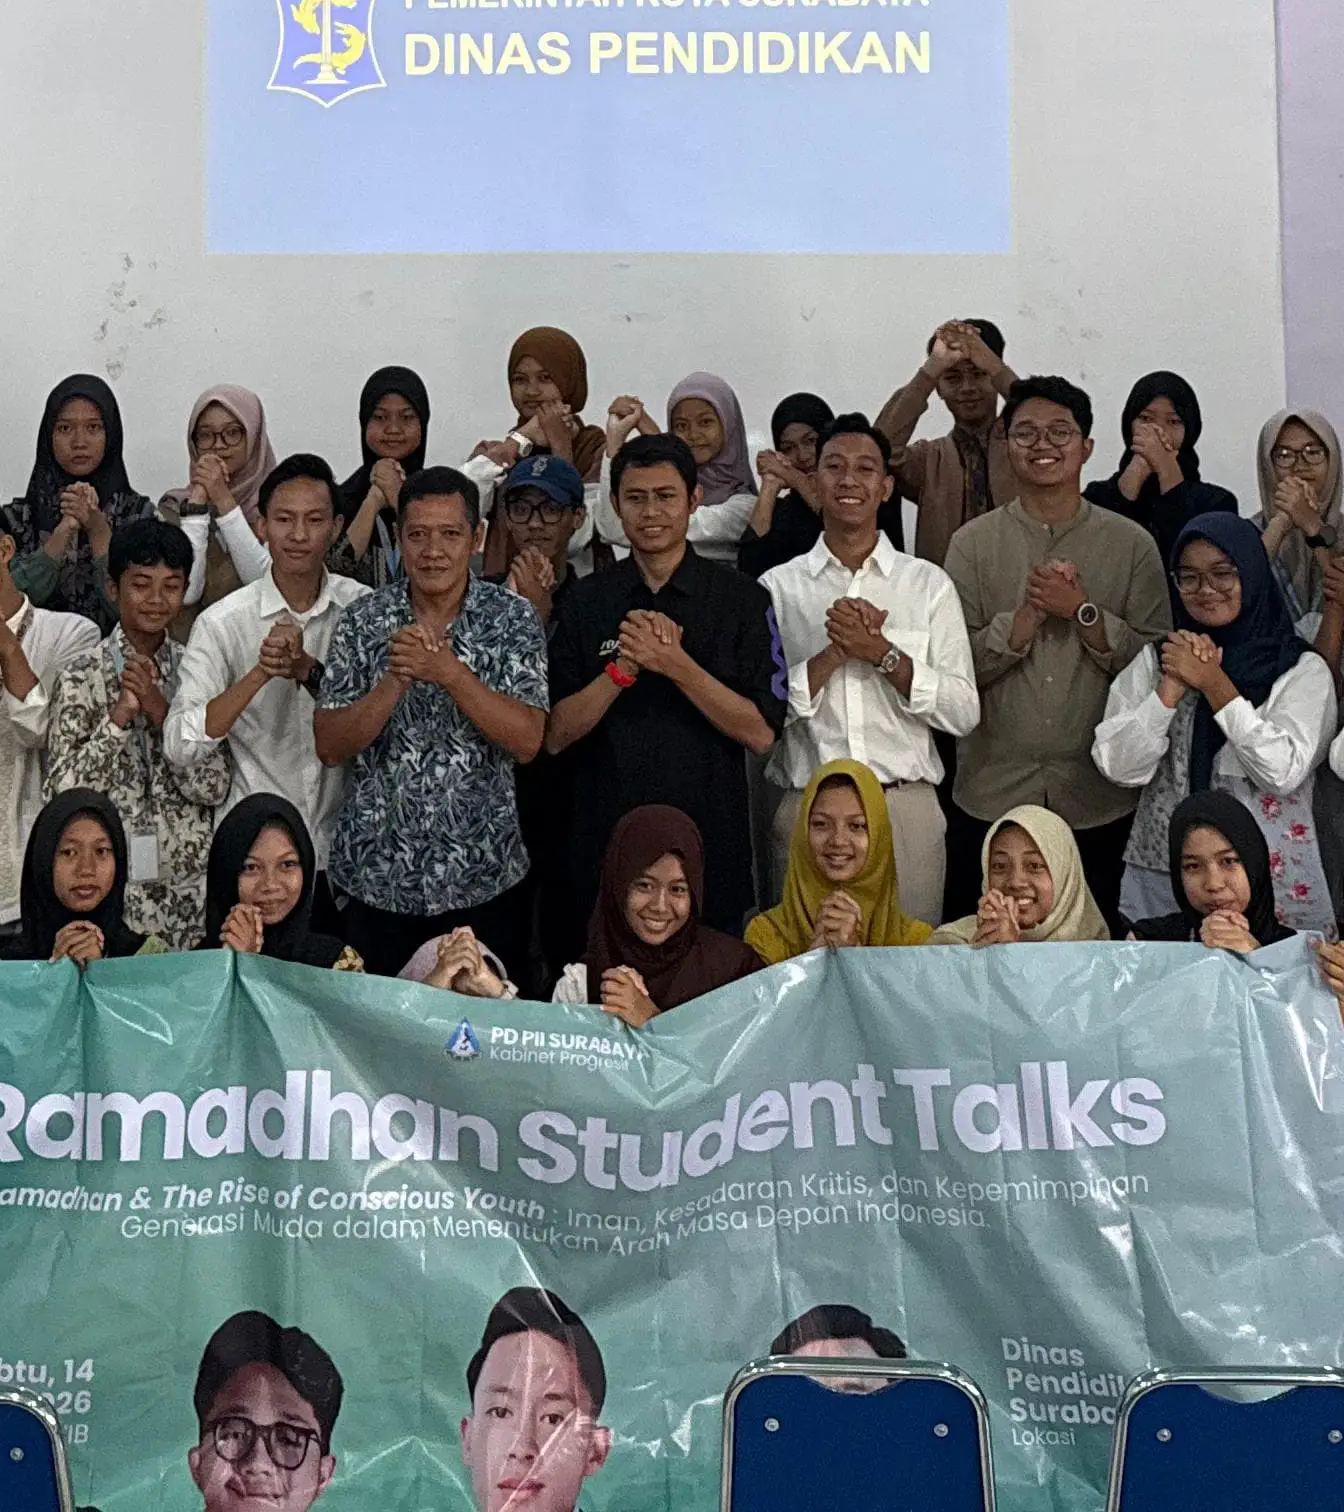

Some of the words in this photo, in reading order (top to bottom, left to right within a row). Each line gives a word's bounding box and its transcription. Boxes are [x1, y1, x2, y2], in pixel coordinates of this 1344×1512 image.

[405, 31, 572, 75] DINAS
[589, 31, 930, 74] PENDIDIKAN
[490, 1026, 518, 1045] PD
[490, 1046, 556, 1065] Kabinet
[517, 1064, 893, 1191] Student
[893, 1061, 1167, 1152] Talks
[129, 1187, 152, 1210] &
[162, 1184, 213, 1209] The
[218, 1177, 269, 1205] Rise
[274, 1184, 303, 1210] of
[307, 1184, 455, 1211] Conscious
[462, 1186, 545, 1221] Youth
[568, 1208, 648, 1236] Iman,
[655, 1177, 793, 1231] Kesadaran
[802, 1170, 873, 1198] Kritis,
[881, 1170, 929, 1197] dan
[936, 1173, 1150, 1207] Kepemimpinan
[121, 1205, 245, 1239] Generasi
[254, 1208, 324, 1240] Muda
[332, 1215, 426, 1239] dalam
[433, 1215, 599, 1253] Menentukan
[608, 1229, 670, 1258] Arah
[676, 1208, 748, 1240] Masa
[757, 1203, 850, 1234] Depan
[857, 1197, 991, 1229] Indonesia.
[1001, 1337, 1085, 1367] Dinas
[64, 1358, 95, 1383] 14
[1009, 1397, 1117, 1425] Suraba
[64, 1423, 90, 1445] IB
[1011, 1426, 1076, 1446] Lokasi
